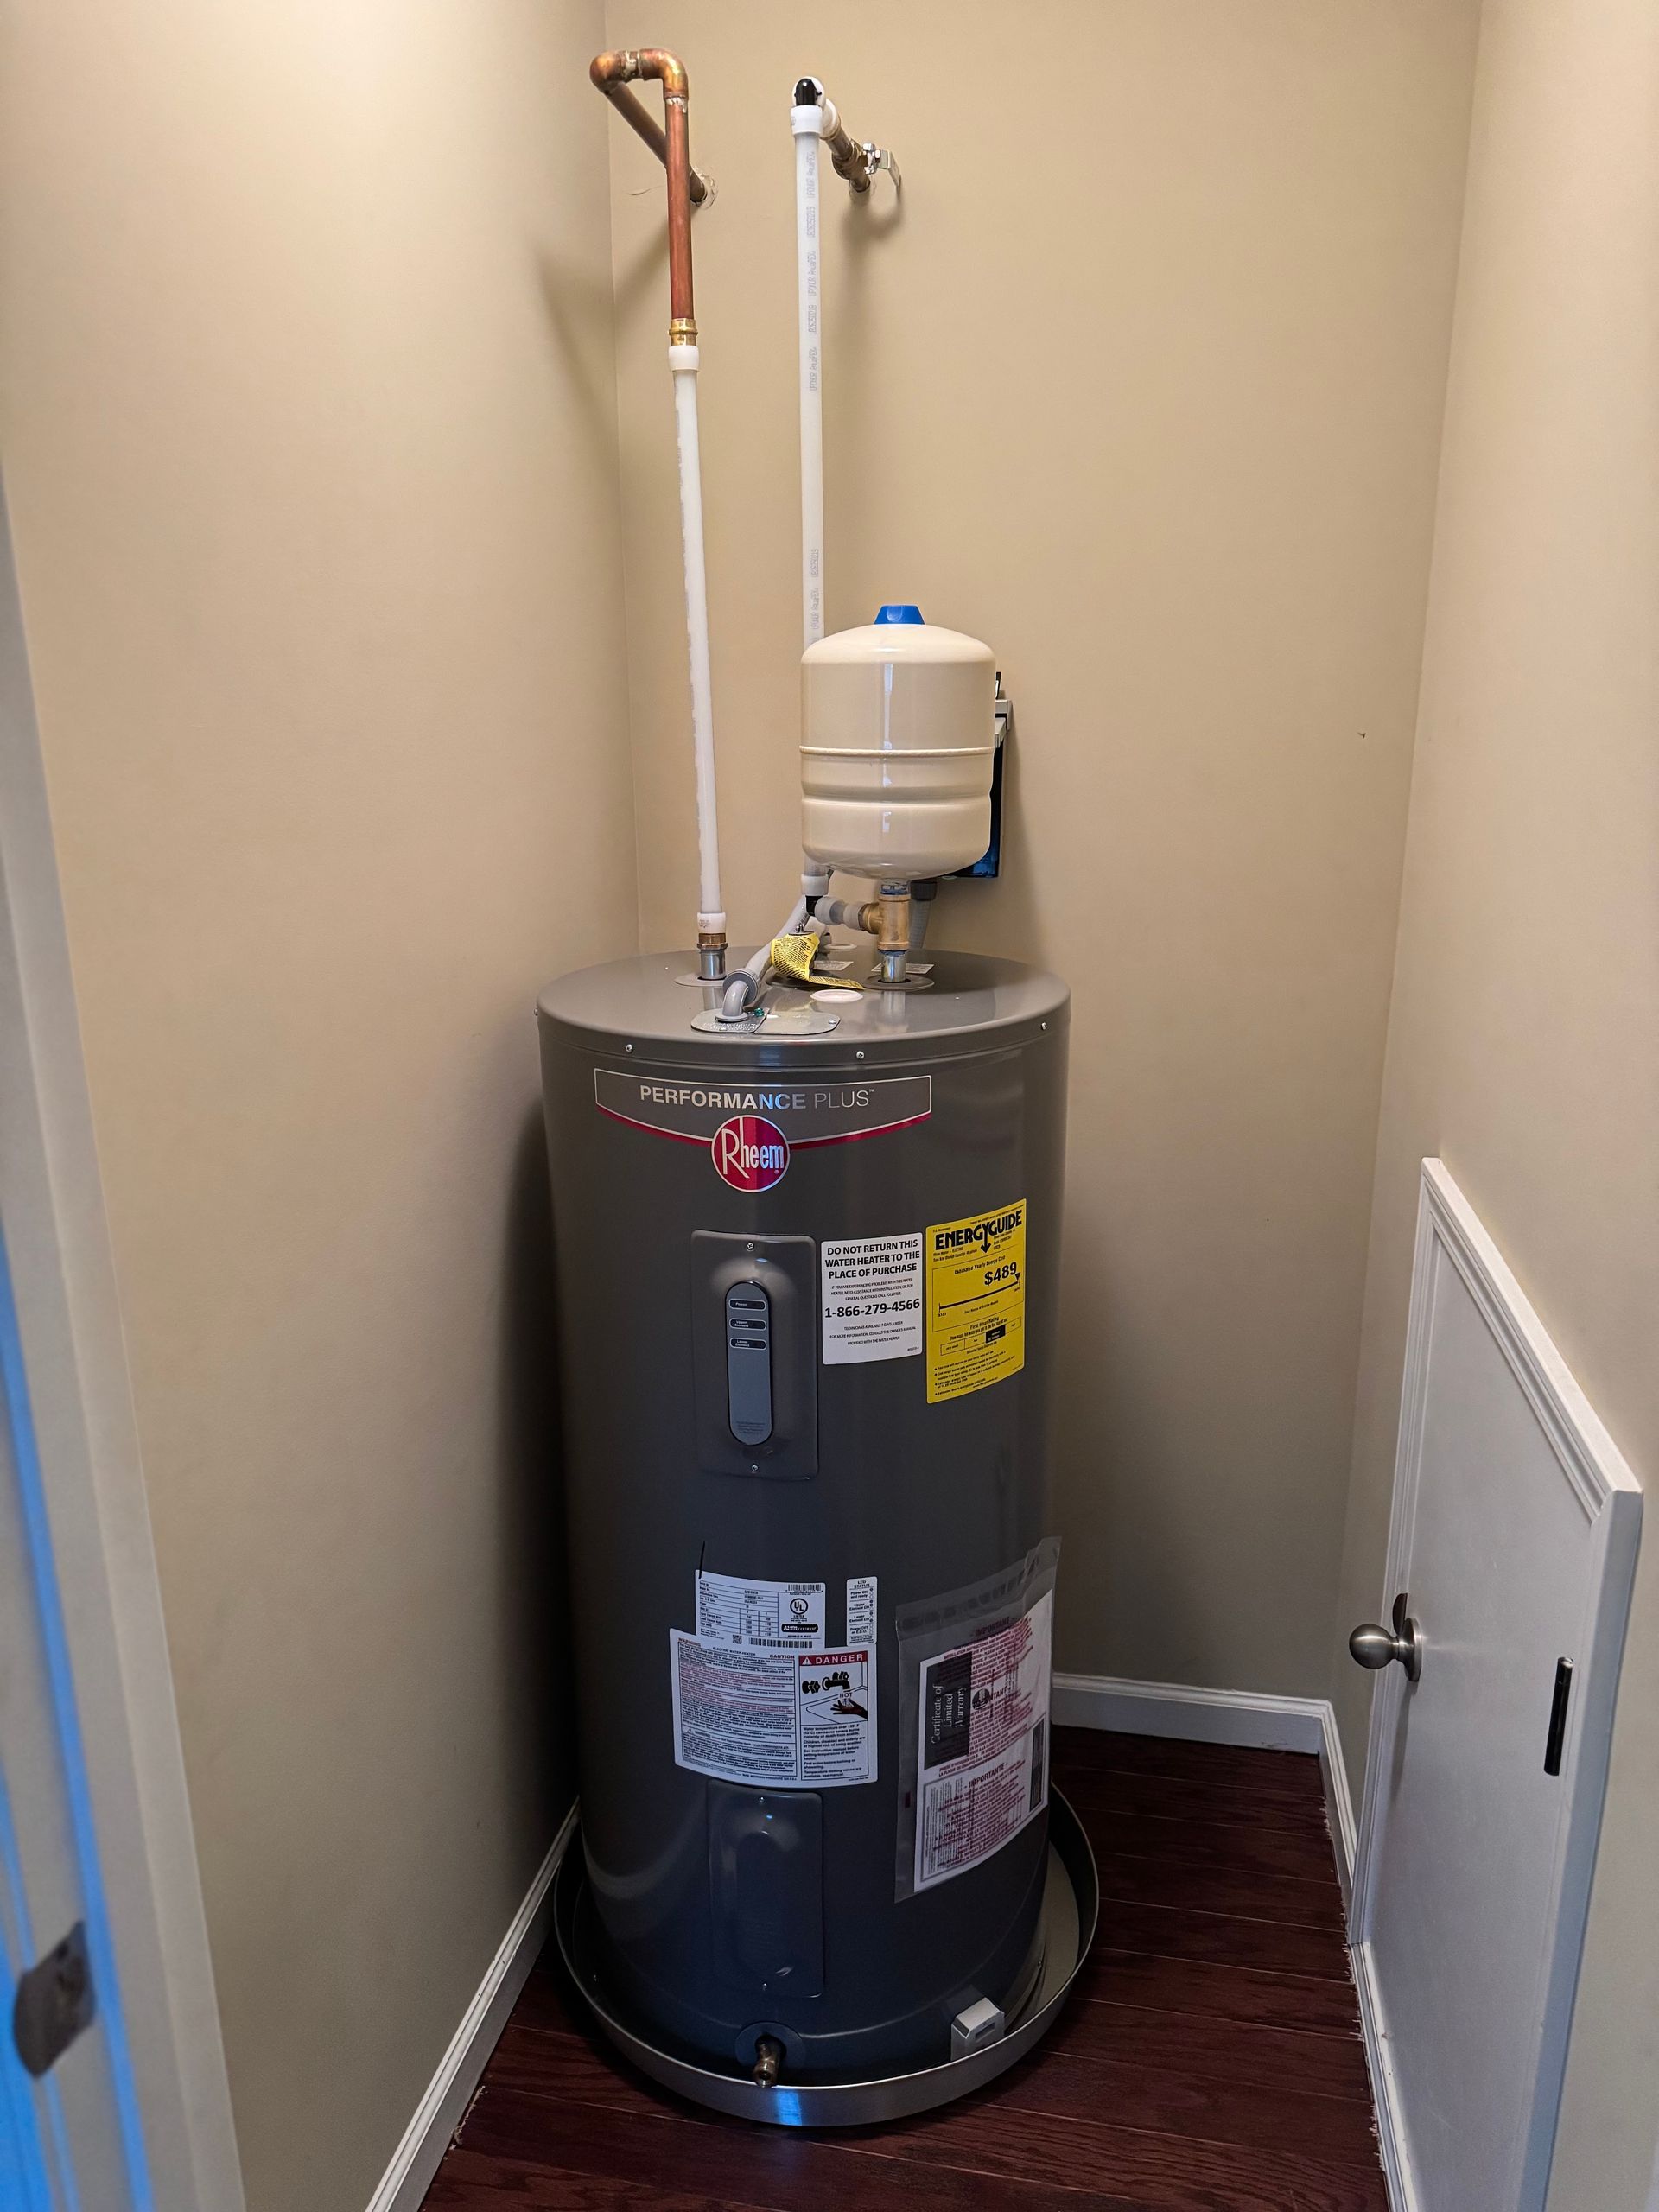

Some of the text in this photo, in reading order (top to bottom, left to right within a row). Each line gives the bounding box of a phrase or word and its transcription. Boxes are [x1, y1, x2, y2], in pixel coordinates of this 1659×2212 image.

[640, 1084, 806, 1110] PERFORMANCE
[721, 1117, 785, 1179] Rheem
[935, 1210, 1022, 1251] ENERGYGUIDE
[843, 1246, 862, 1254] NOT
[864, 1242, 898, 1253] RETURN
[899, 1239, 918, 1249] THIS
[825, 1251, 920, 1267] WATER HEATER TO THE
[829, 1263, 917, 1279] PLACE OF PURCHASE
[984, 1262, 1017, 1286] $489
[825, 1298, 920, 1318] 1-866-279-4566
[794, 1602, 804, 1611] UL
[816, 1654, 863, 1664] DANGER
[931, 1684, 944, 1744] Certificate of
[943, 1693, 953, 1728] Limited
[969, 1764, 1005, 1788] IMPORTANTE
